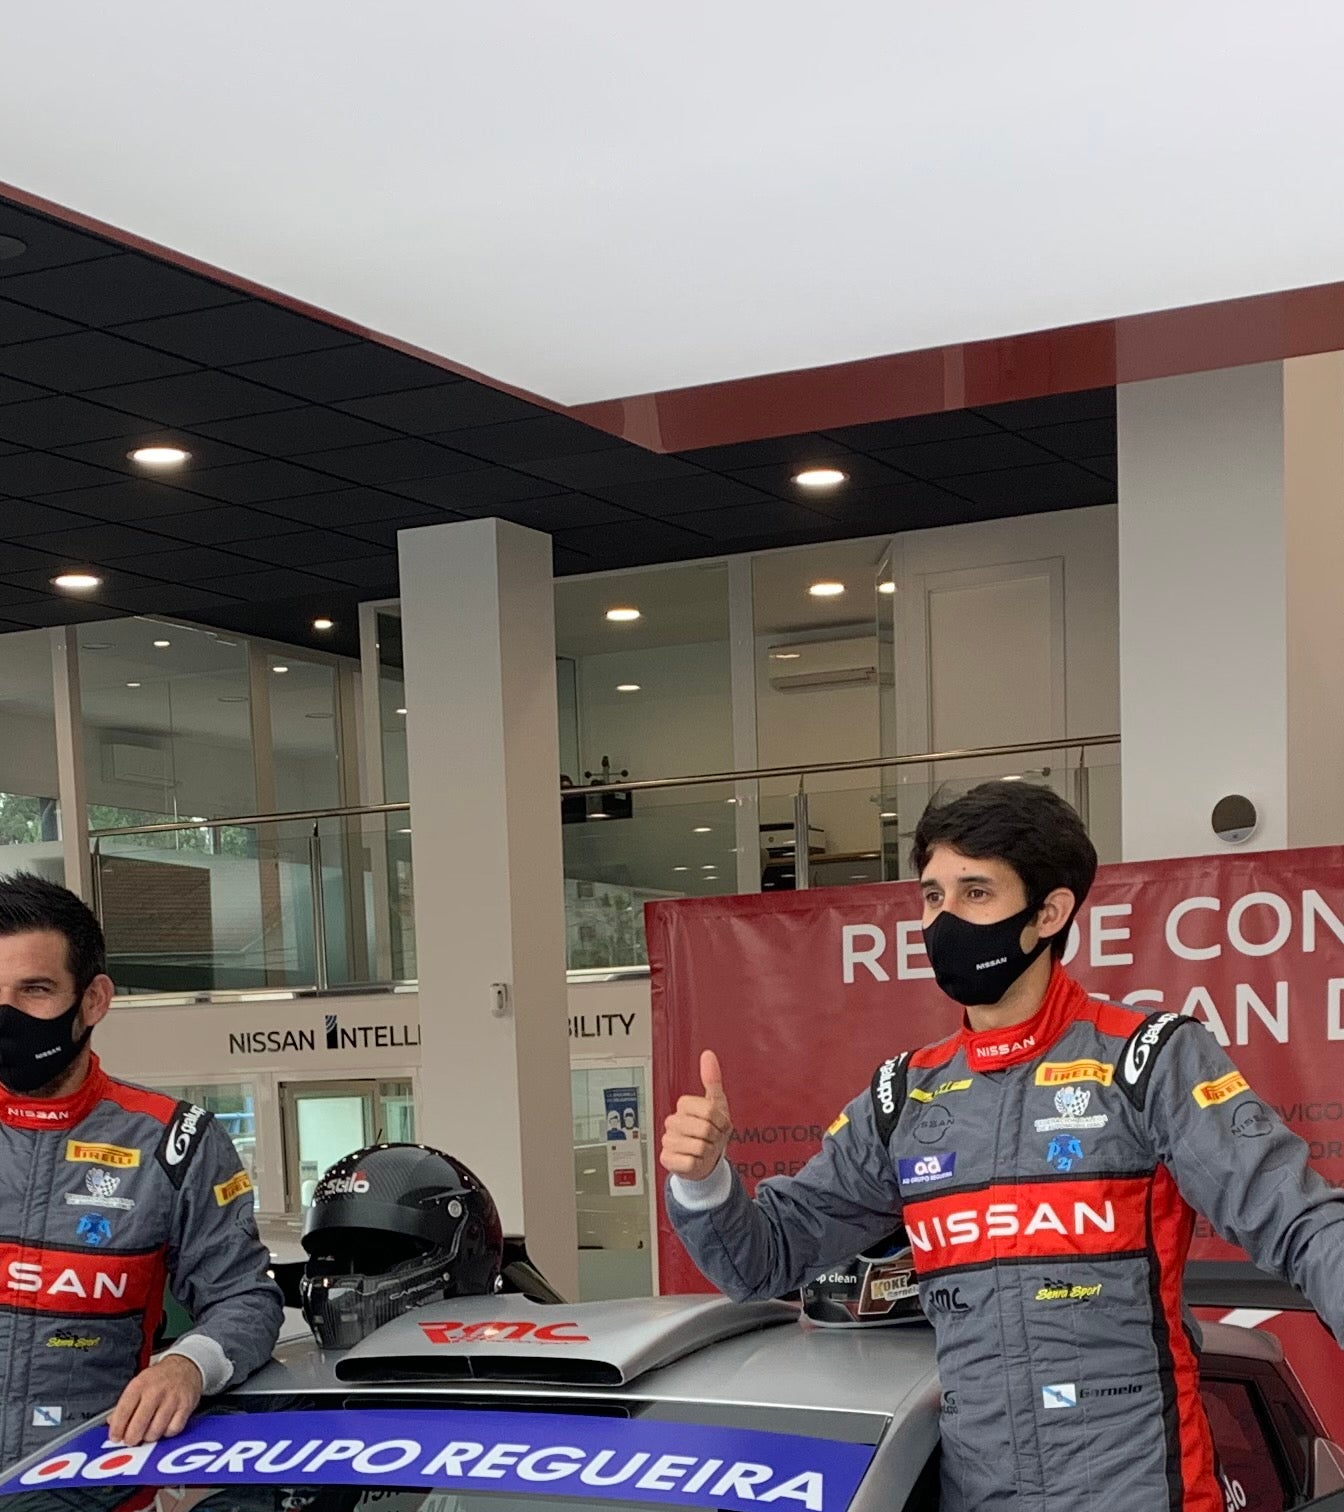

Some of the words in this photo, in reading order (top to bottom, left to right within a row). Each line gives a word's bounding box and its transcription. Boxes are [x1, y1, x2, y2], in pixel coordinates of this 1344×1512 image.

[841, 920, 935, 984] RE
[230, 1029, 316, 1054] NISSAN
[976, 1035, 1036, 1058] NISSAN
[1043, 1063, 1109, 1082] PIRELLI
[7, 1106, 71, 1122] NISSAN
[74, 1145, 133, 1165] PIRELLI
[905, 1200, 1116, 1255] NISSAN
[156, 1437, 419, 1476] GRUPO
[421, 1441, 825, 1512] REGUEIRA
